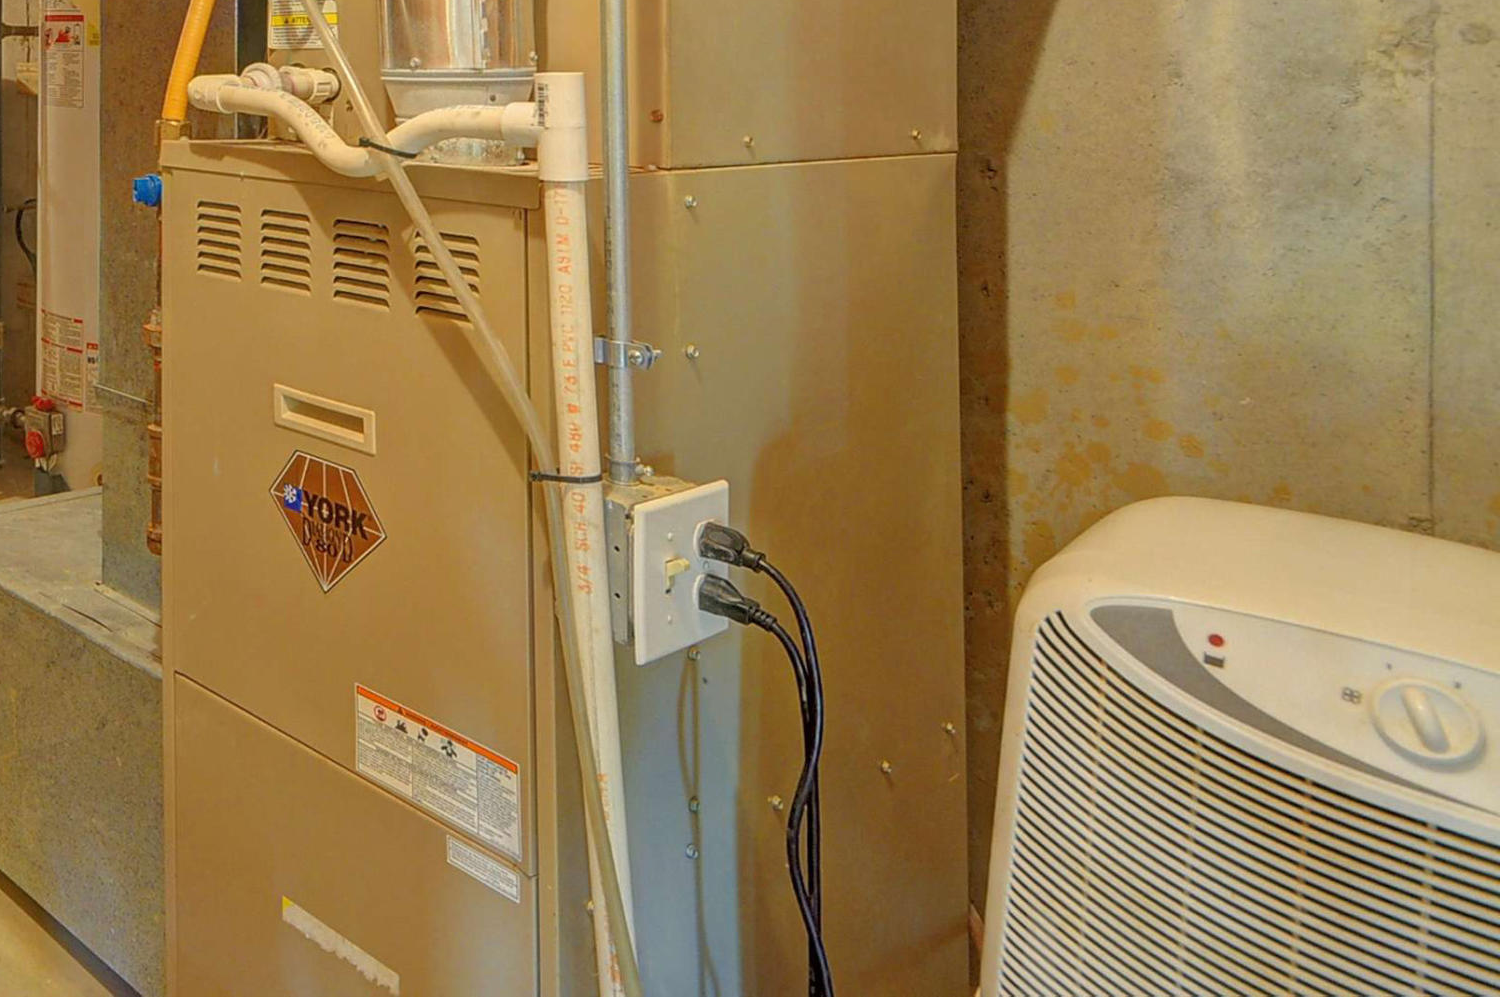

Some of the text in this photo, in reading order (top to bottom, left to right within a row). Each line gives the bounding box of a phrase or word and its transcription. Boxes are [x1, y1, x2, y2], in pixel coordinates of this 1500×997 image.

[302, 490, 368, 540] YORK
[571, 492, 586, 515] 40
[315, 539, 338, 558] 80
